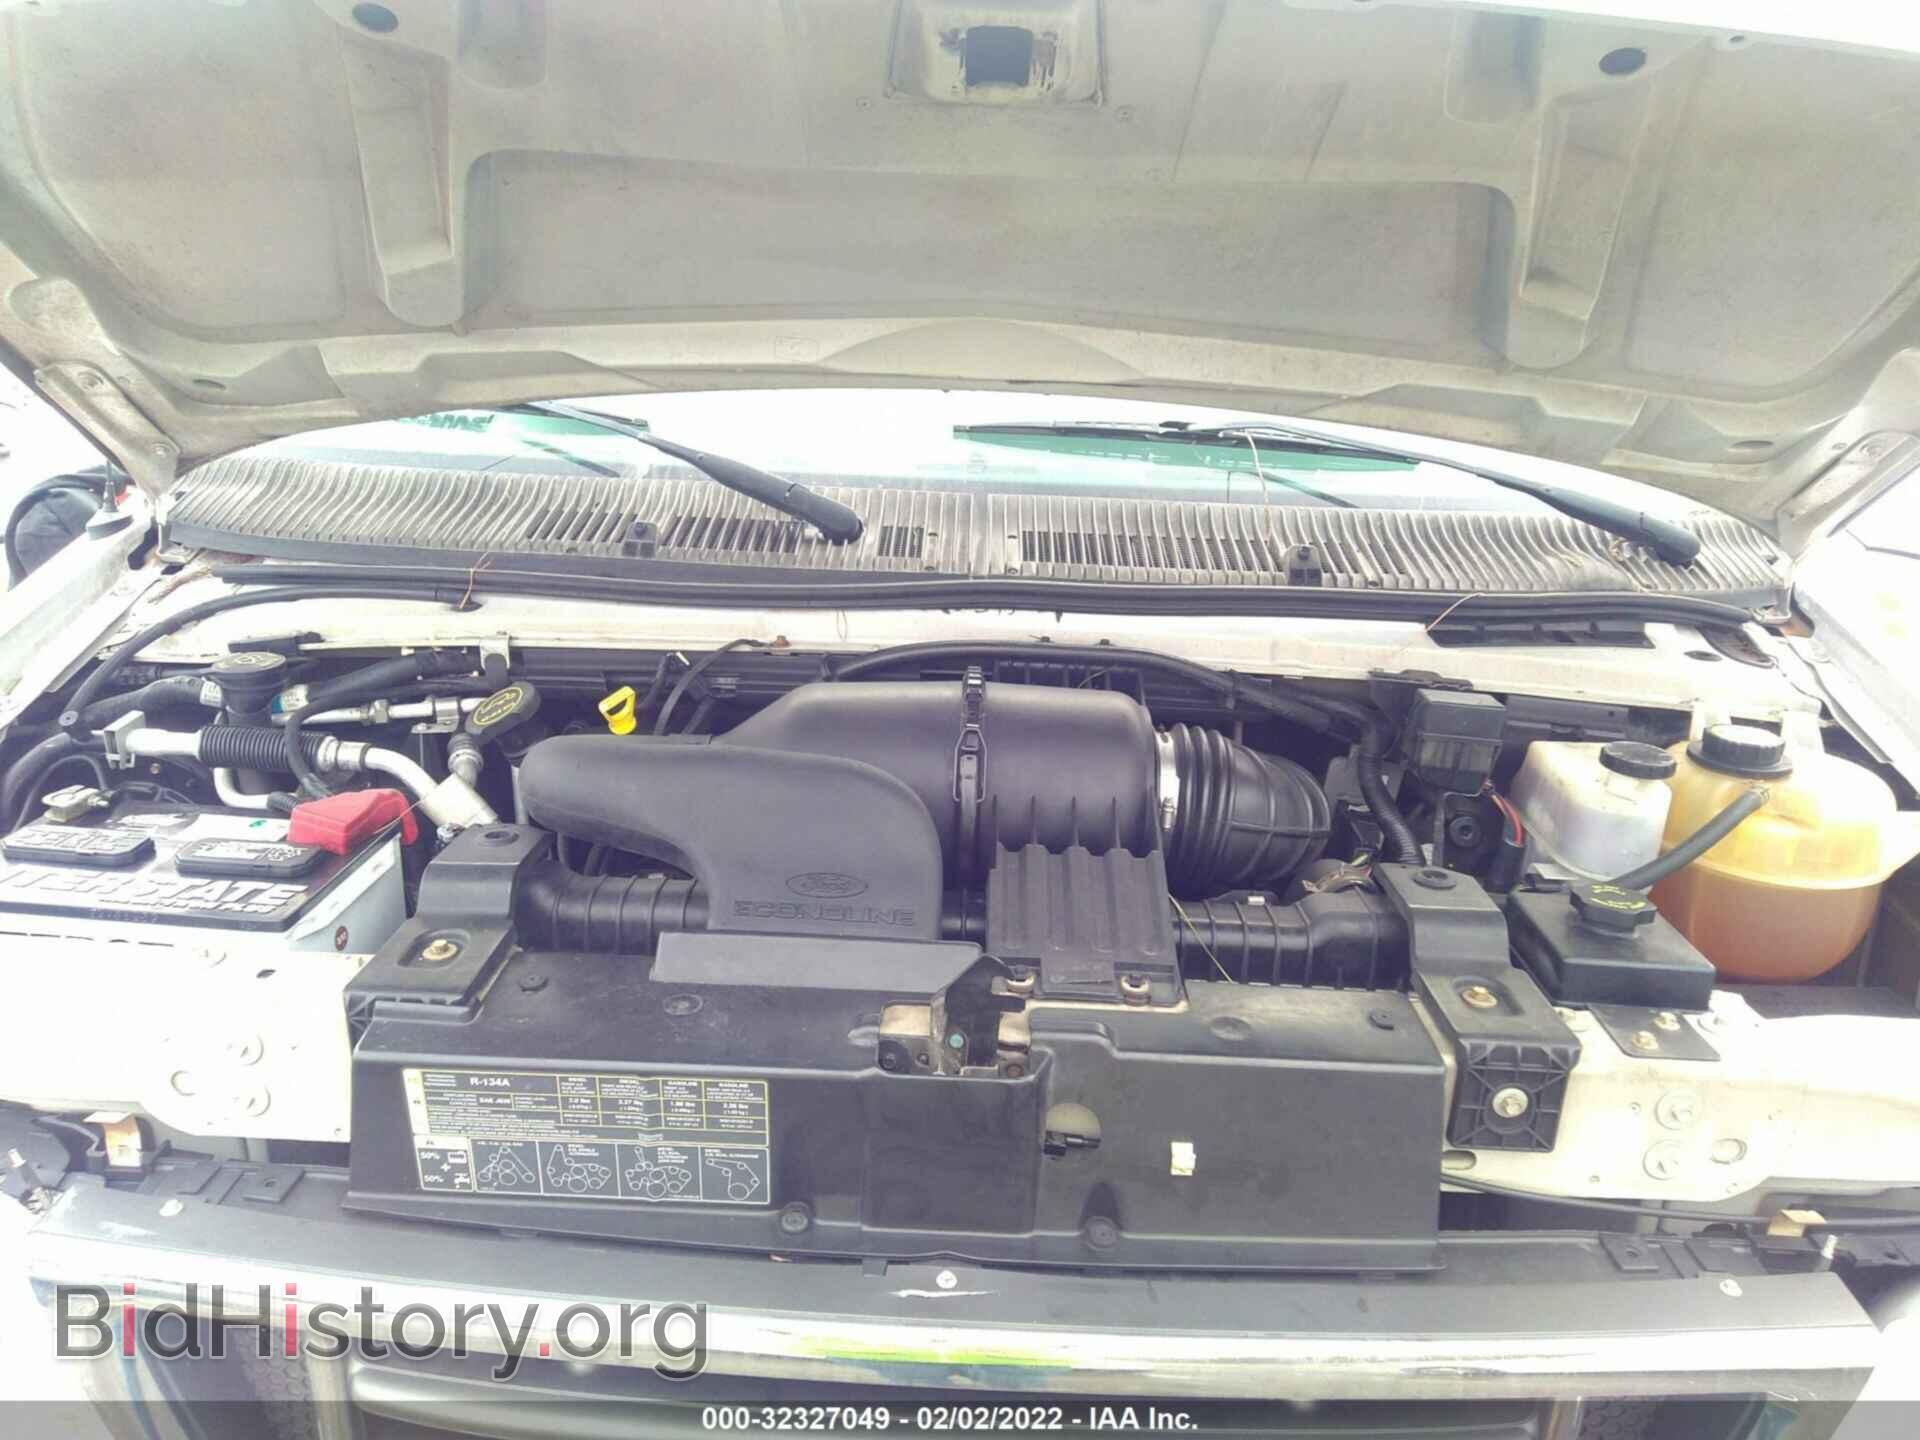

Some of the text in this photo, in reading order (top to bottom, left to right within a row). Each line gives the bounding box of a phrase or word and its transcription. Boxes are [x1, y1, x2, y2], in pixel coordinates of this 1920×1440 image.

[734, 899, 915, 927] ECONOLINE
[469, 1076, 511, 1087] R-134A
[420, 1151, 440, 1160] 50%
[424, 1174, 444, 1183] 50%
